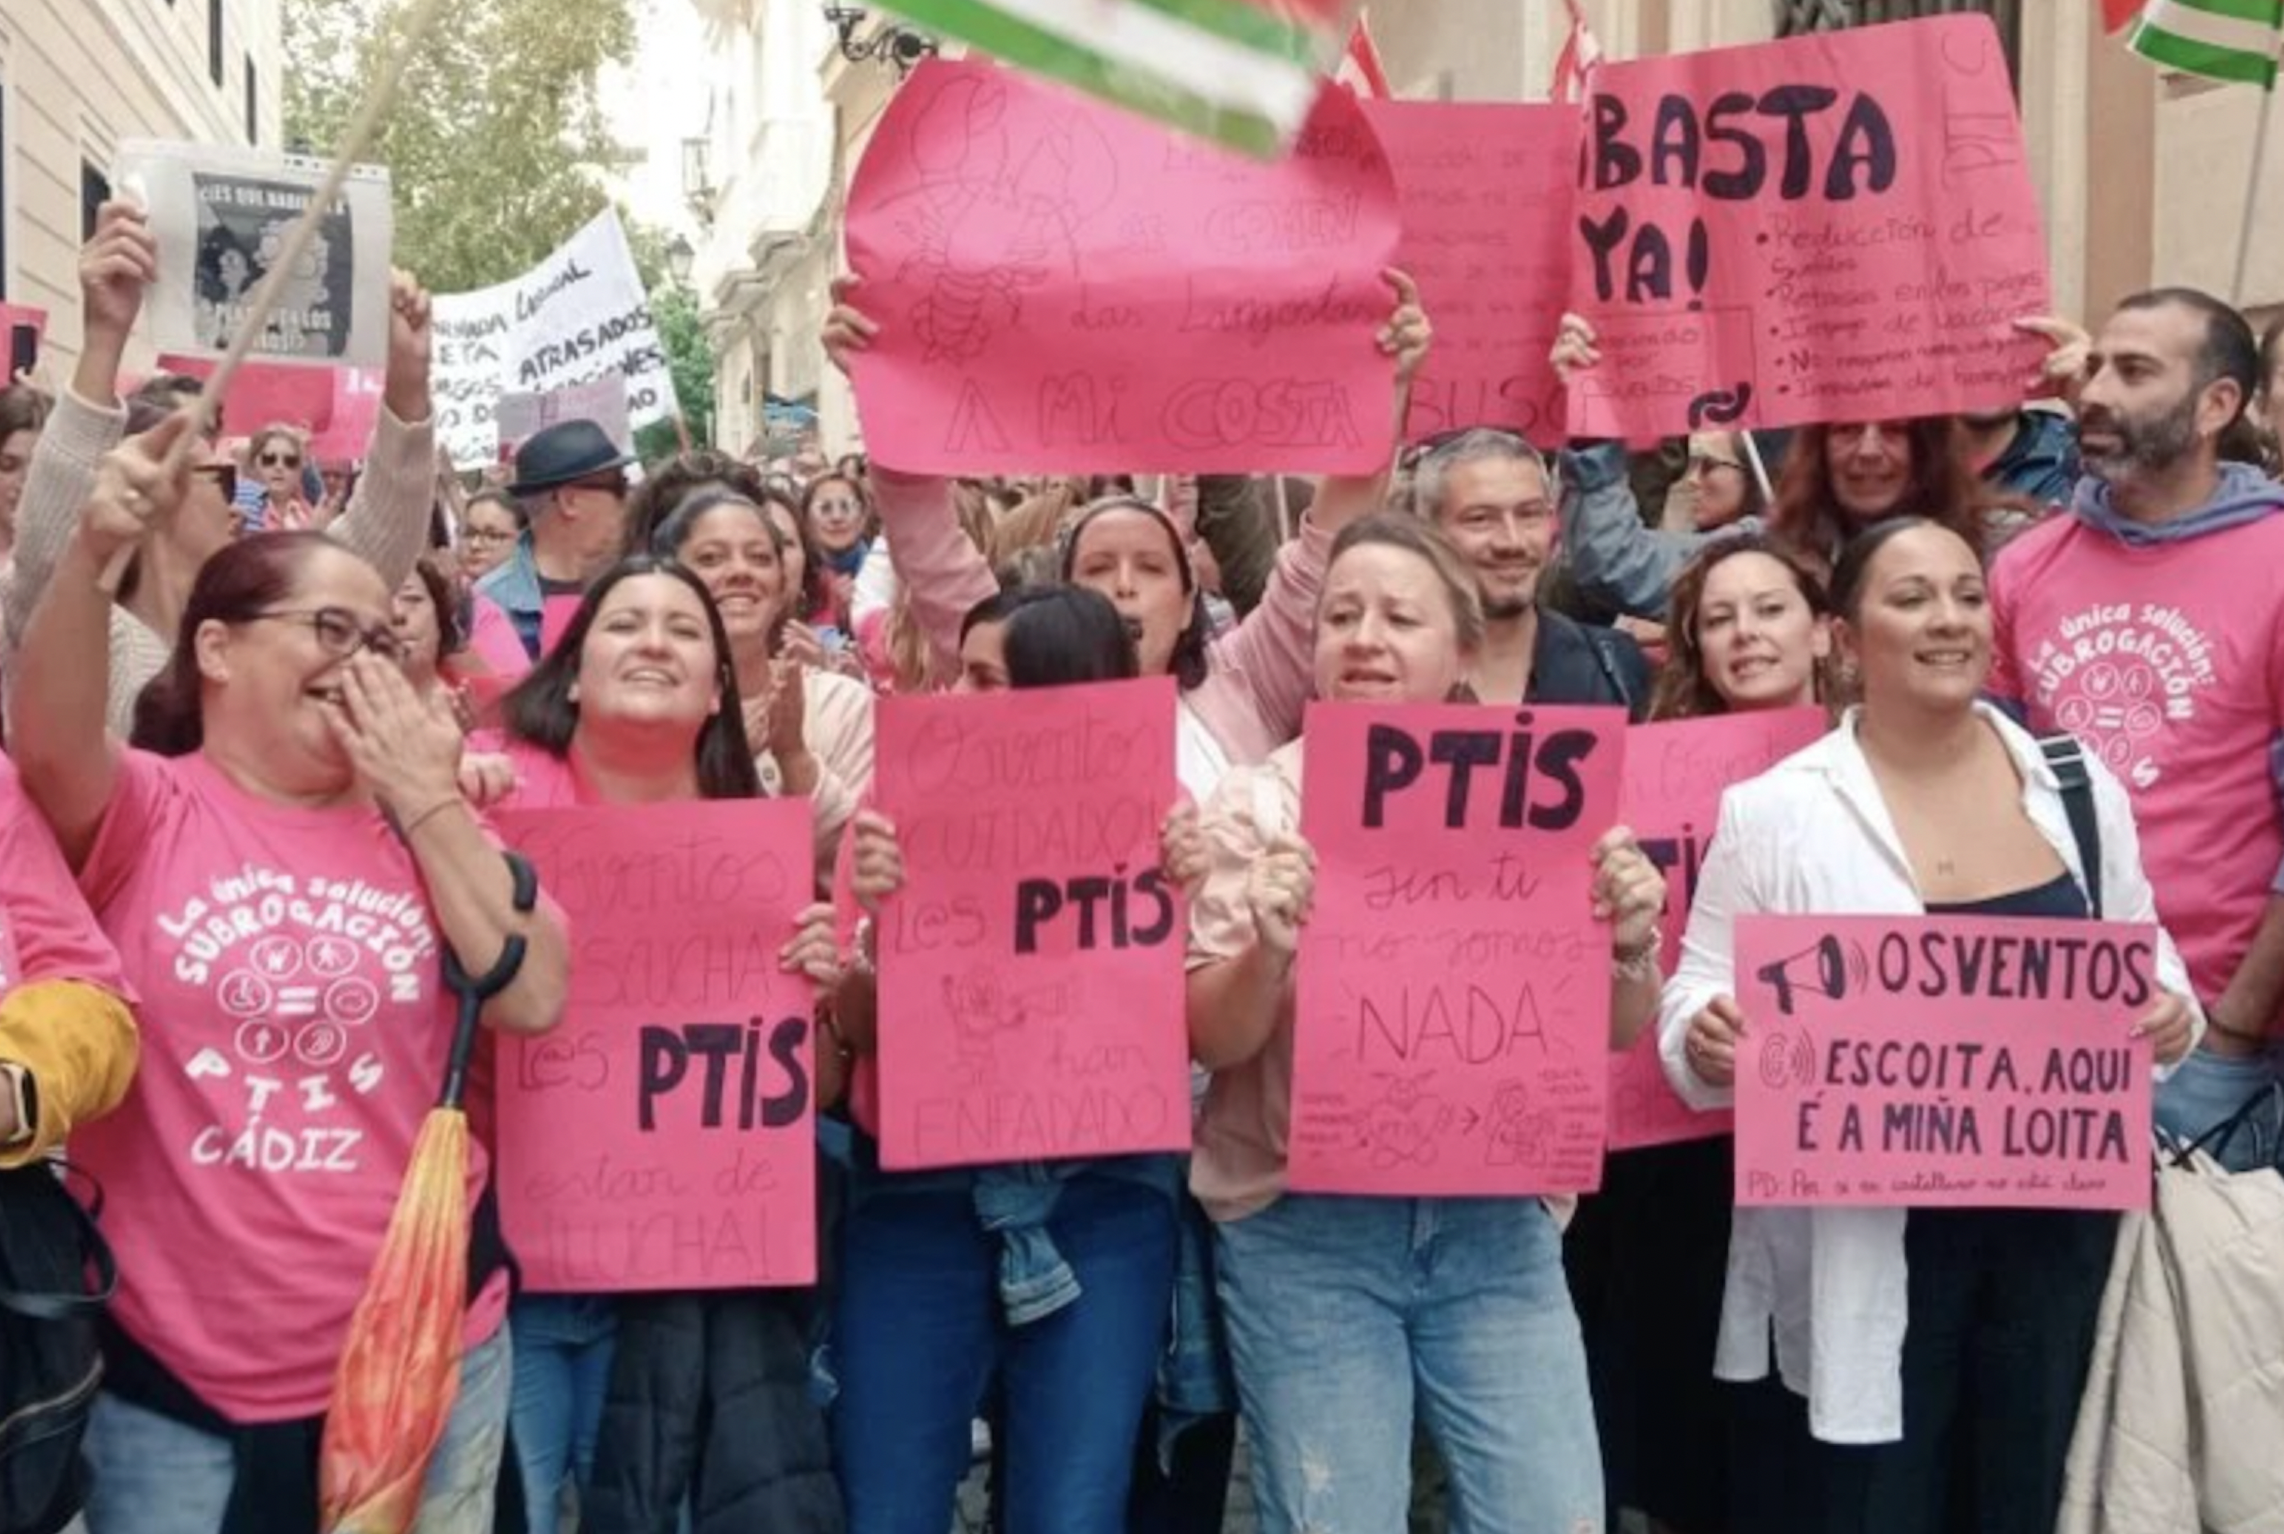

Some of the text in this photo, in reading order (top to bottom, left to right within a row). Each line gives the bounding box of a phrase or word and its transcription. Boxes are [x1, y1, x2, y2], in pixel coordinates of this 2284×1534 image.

[1579, 205, 1709, 311] YA!
[1951, 208, 2003, 245] de
[519, 304, 654, 387] ATRASADOS
[1161, 375, 1363, 451] COSTA
[157, 898, 207, 936] La
[175, 893, 420, 1003] SUBROGACIÓN
[1877, 931, 2153, 1007] OSVENTOS
[1358, 982, 1547, 1065] NADA
[184, 1047, 384, 1113] PTIS
[2042, 1046, 2132, 1095] AQUI
[190, 1117, 362, 1172] CÁDIZ
[1796, 1090, 2130, 1165] É A MIÑA LOITA
[713, 1146, 777, 1198] de
